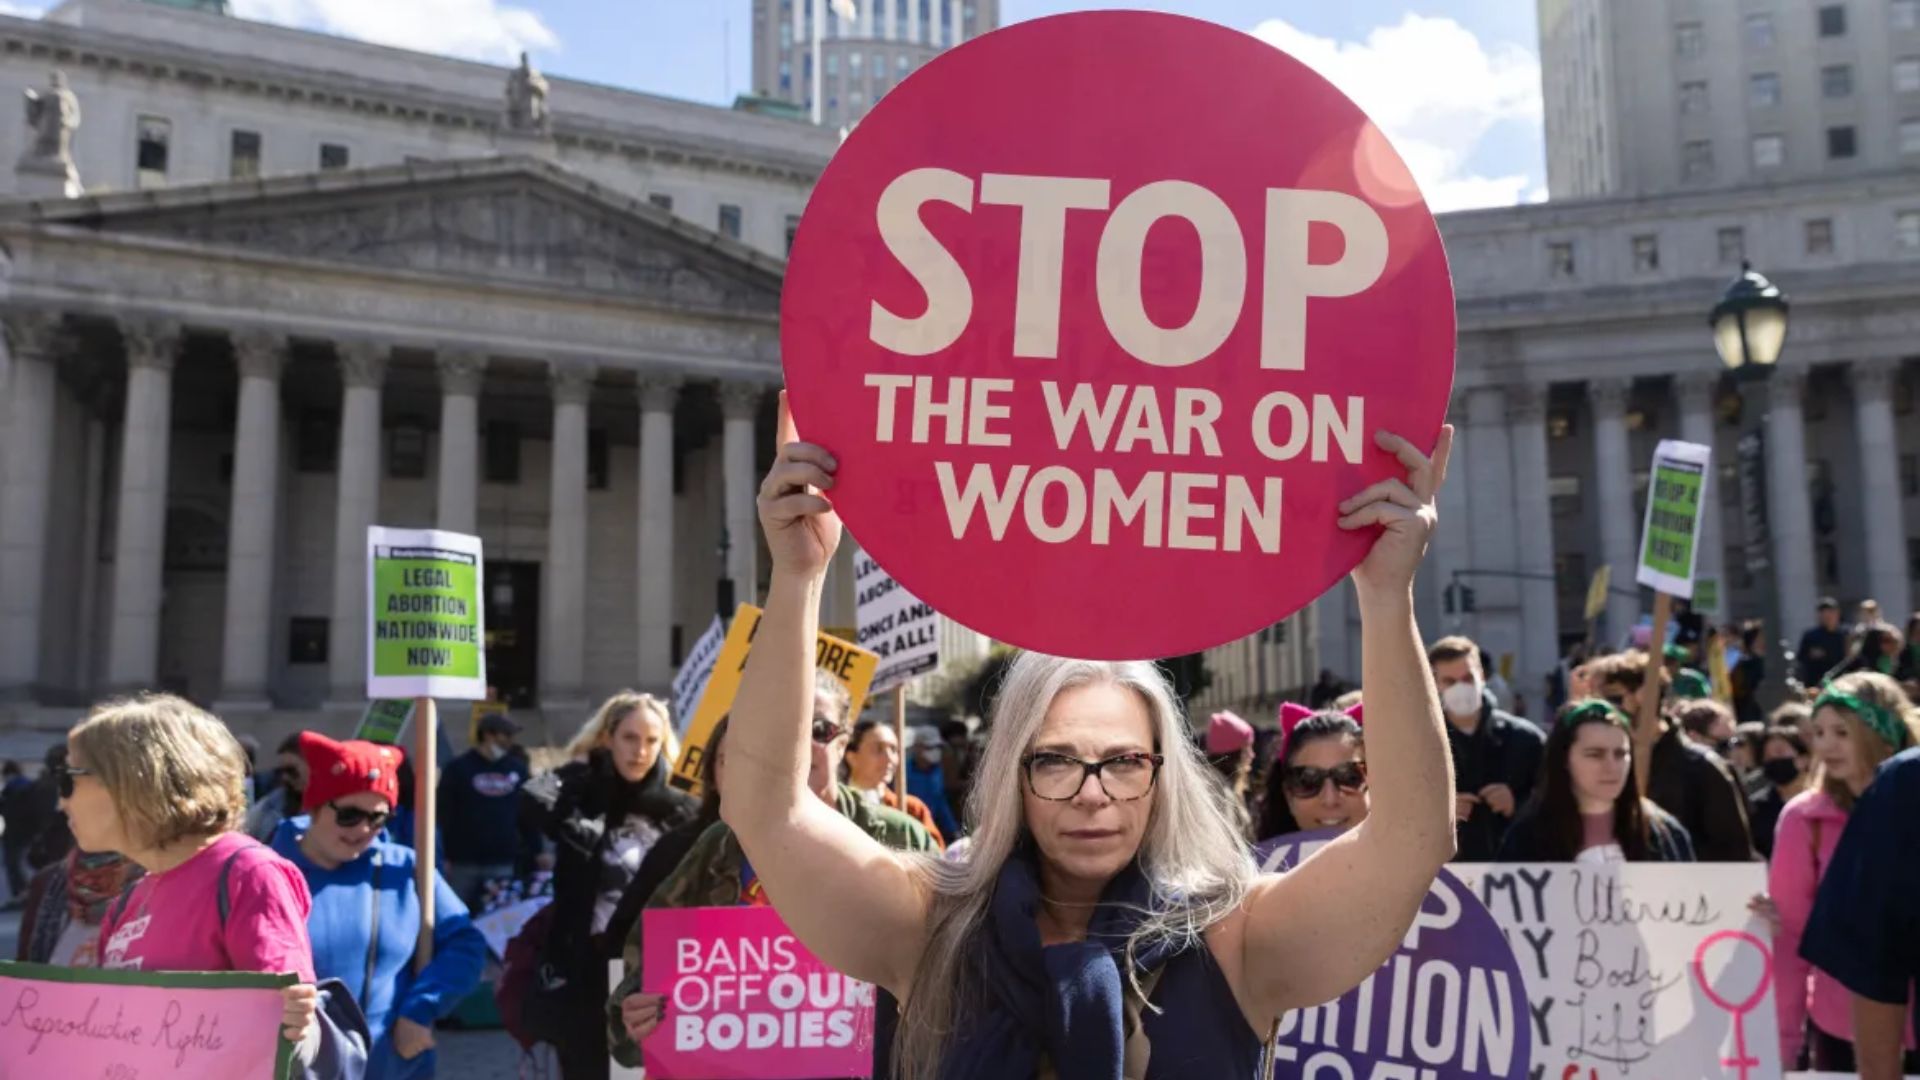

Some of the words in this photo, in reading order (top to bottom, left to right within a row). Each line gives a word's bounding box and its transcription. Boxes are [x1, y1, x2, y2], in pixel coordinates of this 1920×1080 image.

[868, 167, 1389, 371] STOP
[864, 373, 1014, 447] THE
[1042, 381, 1223, 456] WAR
[1251, 391, 1364, 464] ON
[934, 461, 1283, 554] WOMEN
[403, 568, 452, 588] LEGAL
[858, 578, 900, 606] ABOR
[388, 594, 466, 615] ABORTION
[376, 620, 477, 642] NATIONWIDE
[894, 624, 935, 653] ALL!
[407, 647, 451, 666] NOW!
[1484, 868, 1552, 923] MY
[1571, 869, 1721, 925] Uterus
[676, 935, 797, 973] BANS
[1574, 928, 1683, 1010] Body
[673, 975, 762, 1012] OFF
[768, 972, 875, 1010] OUR
[1, 987, 142, 1054] Reproductive
[151, 1000, 224, 1067] Rights
[675, 1011, 855, 1051] BODIES
[1566, 992, 1658, 1075] Life
